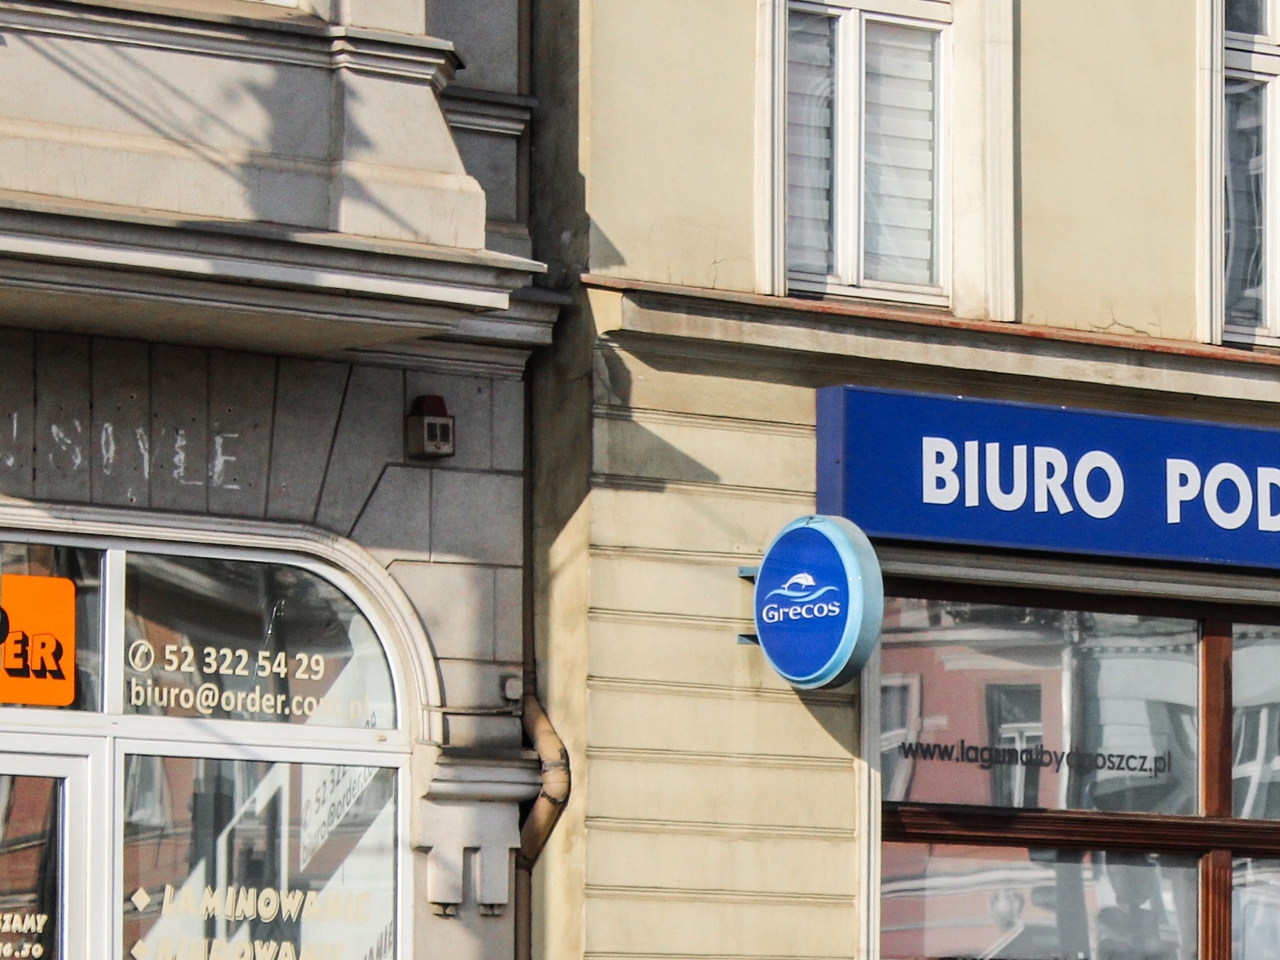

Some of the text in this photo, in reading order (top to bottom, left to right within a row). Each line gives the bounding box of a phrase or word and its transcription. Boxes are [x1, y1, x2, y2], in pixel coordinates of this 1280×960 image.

[921, 436, 1125, 520] BIURO
[762, 601, 840, 623] Grecos
[164, 645, 325, 681] 52 322 54 29
[161, 884, 371, 923] LAMINOWANIE
